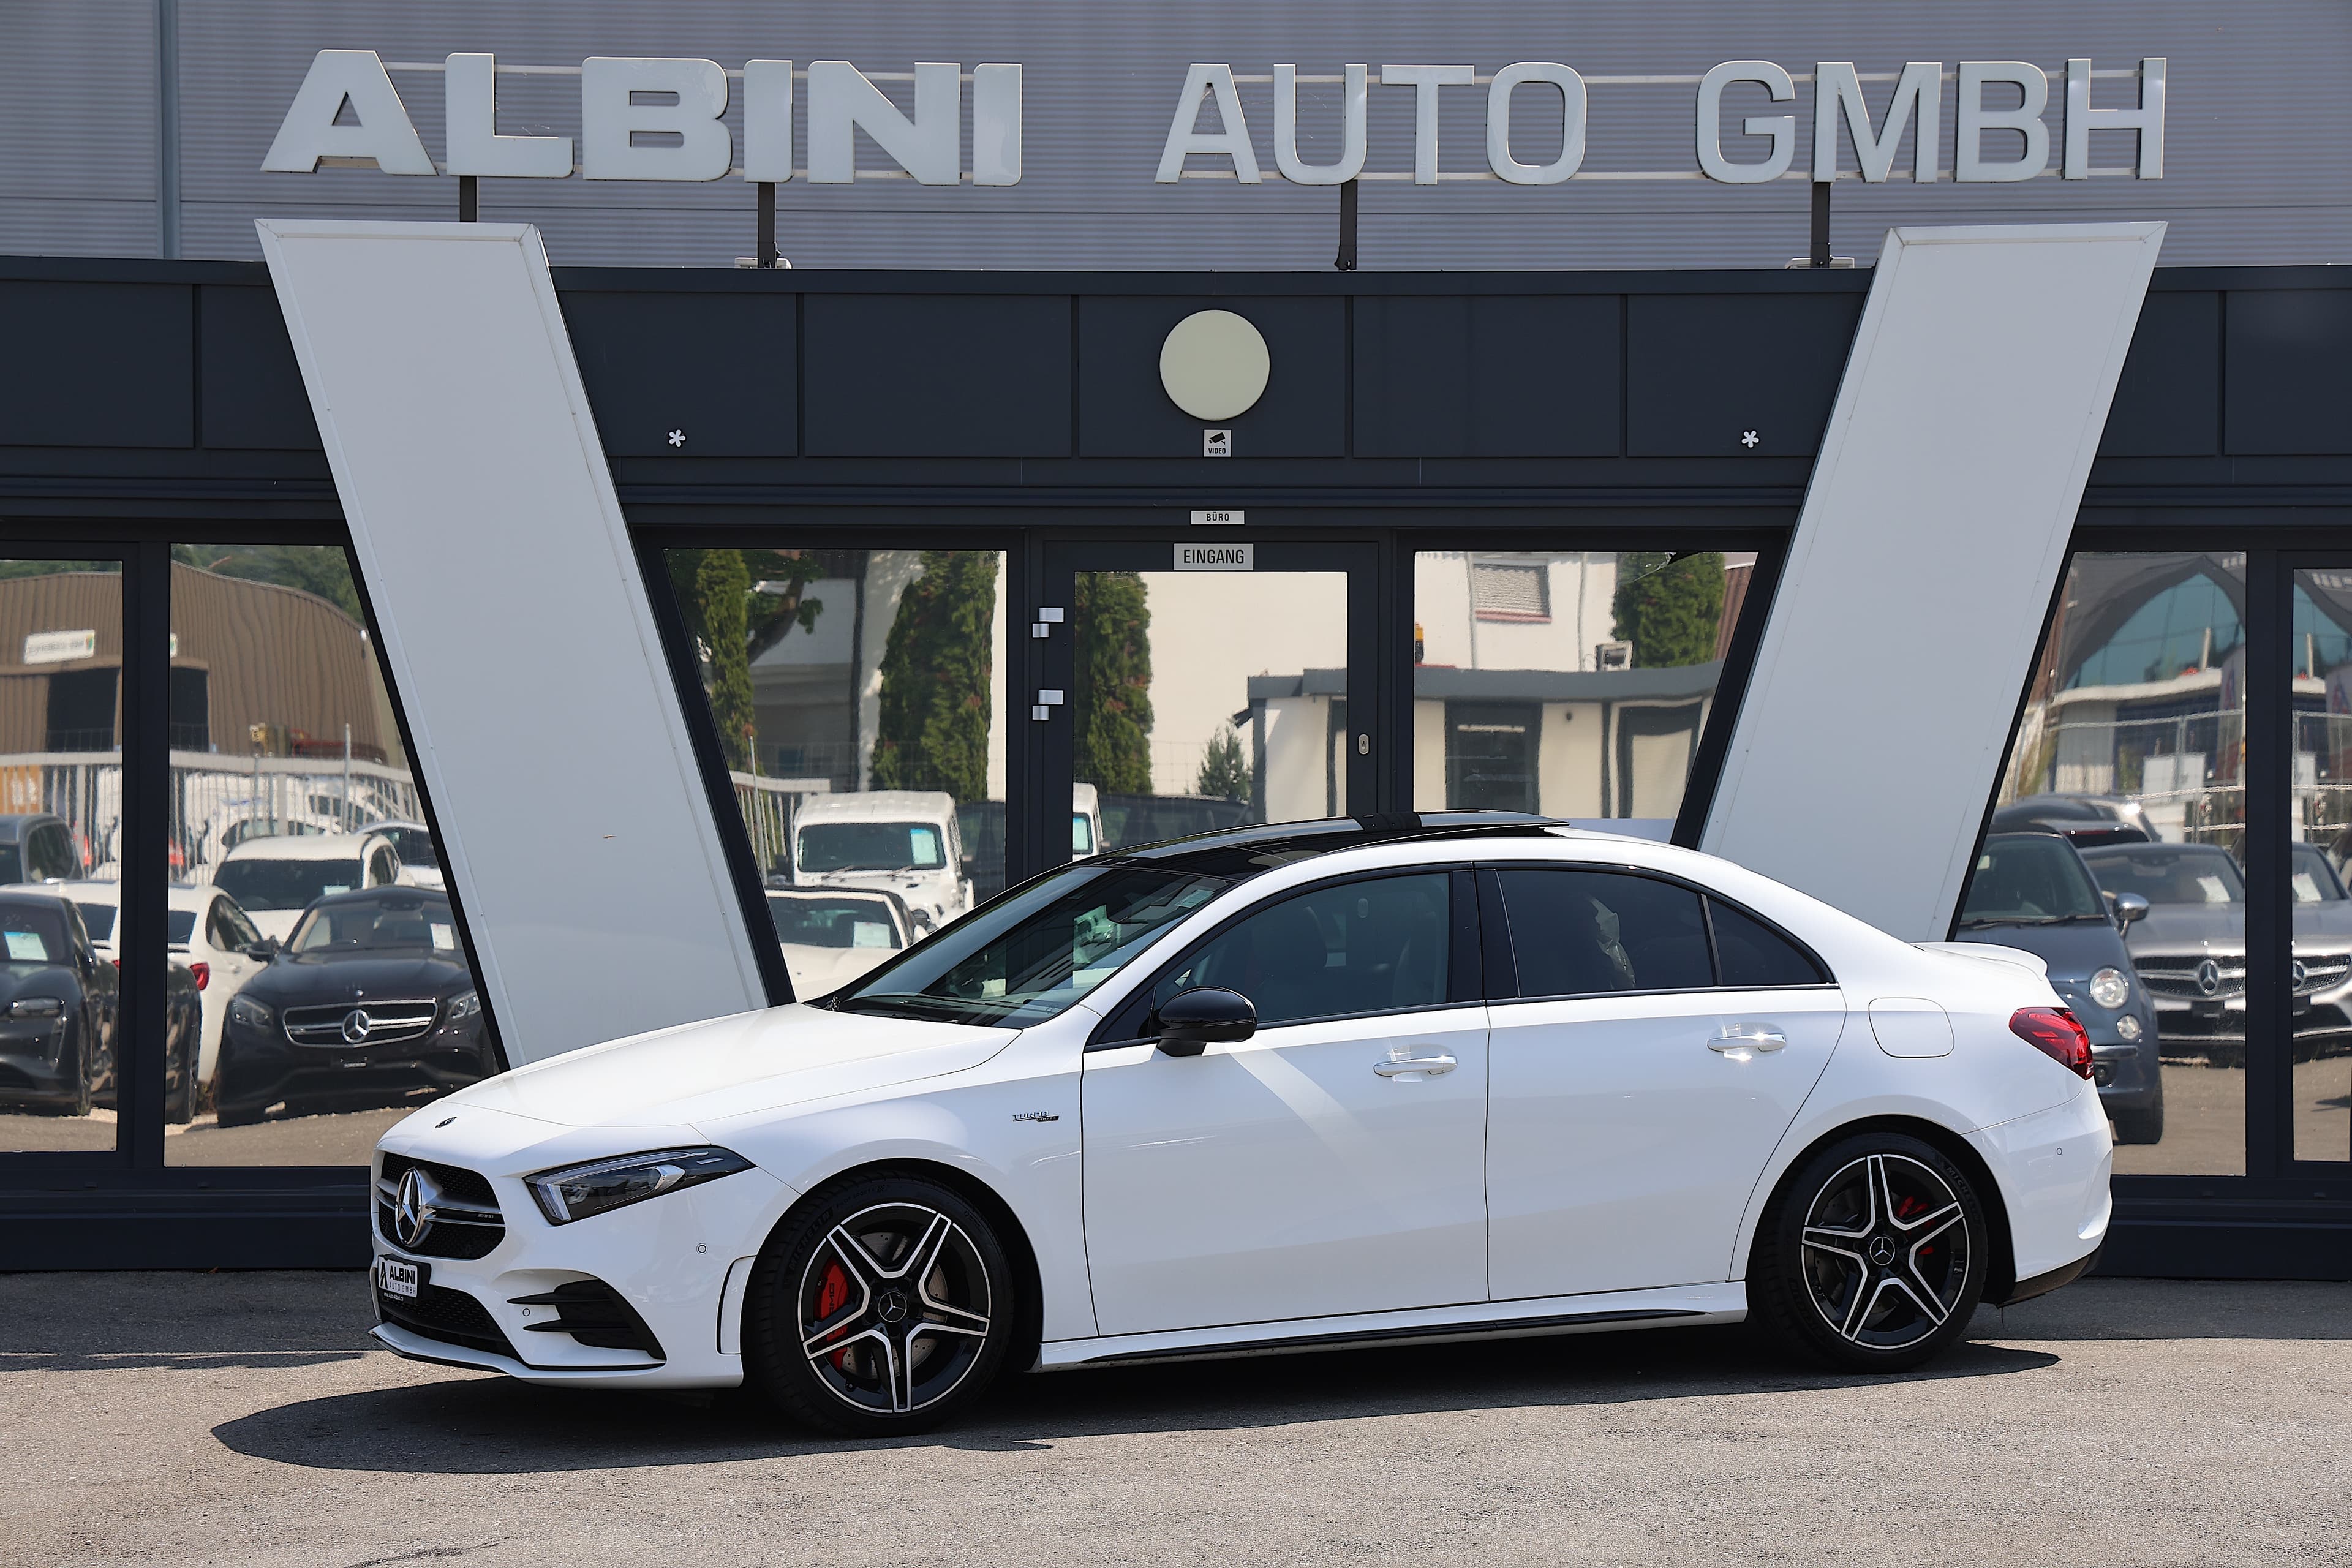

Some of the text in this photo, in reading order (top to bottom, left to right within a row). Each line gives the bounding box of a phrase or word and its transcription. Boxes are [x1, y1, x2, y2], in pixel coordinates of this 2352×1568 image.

[260, 49, 2167, 187] ALBINI AUTO GMBH
[1206, 511, 1230, 521] BÜRO
[1183, 549, 1245, 564] EINGANG
[1012, 1111, 1049, 1120] TURBO
[389, 1265, 416, 1285] ALBINI
